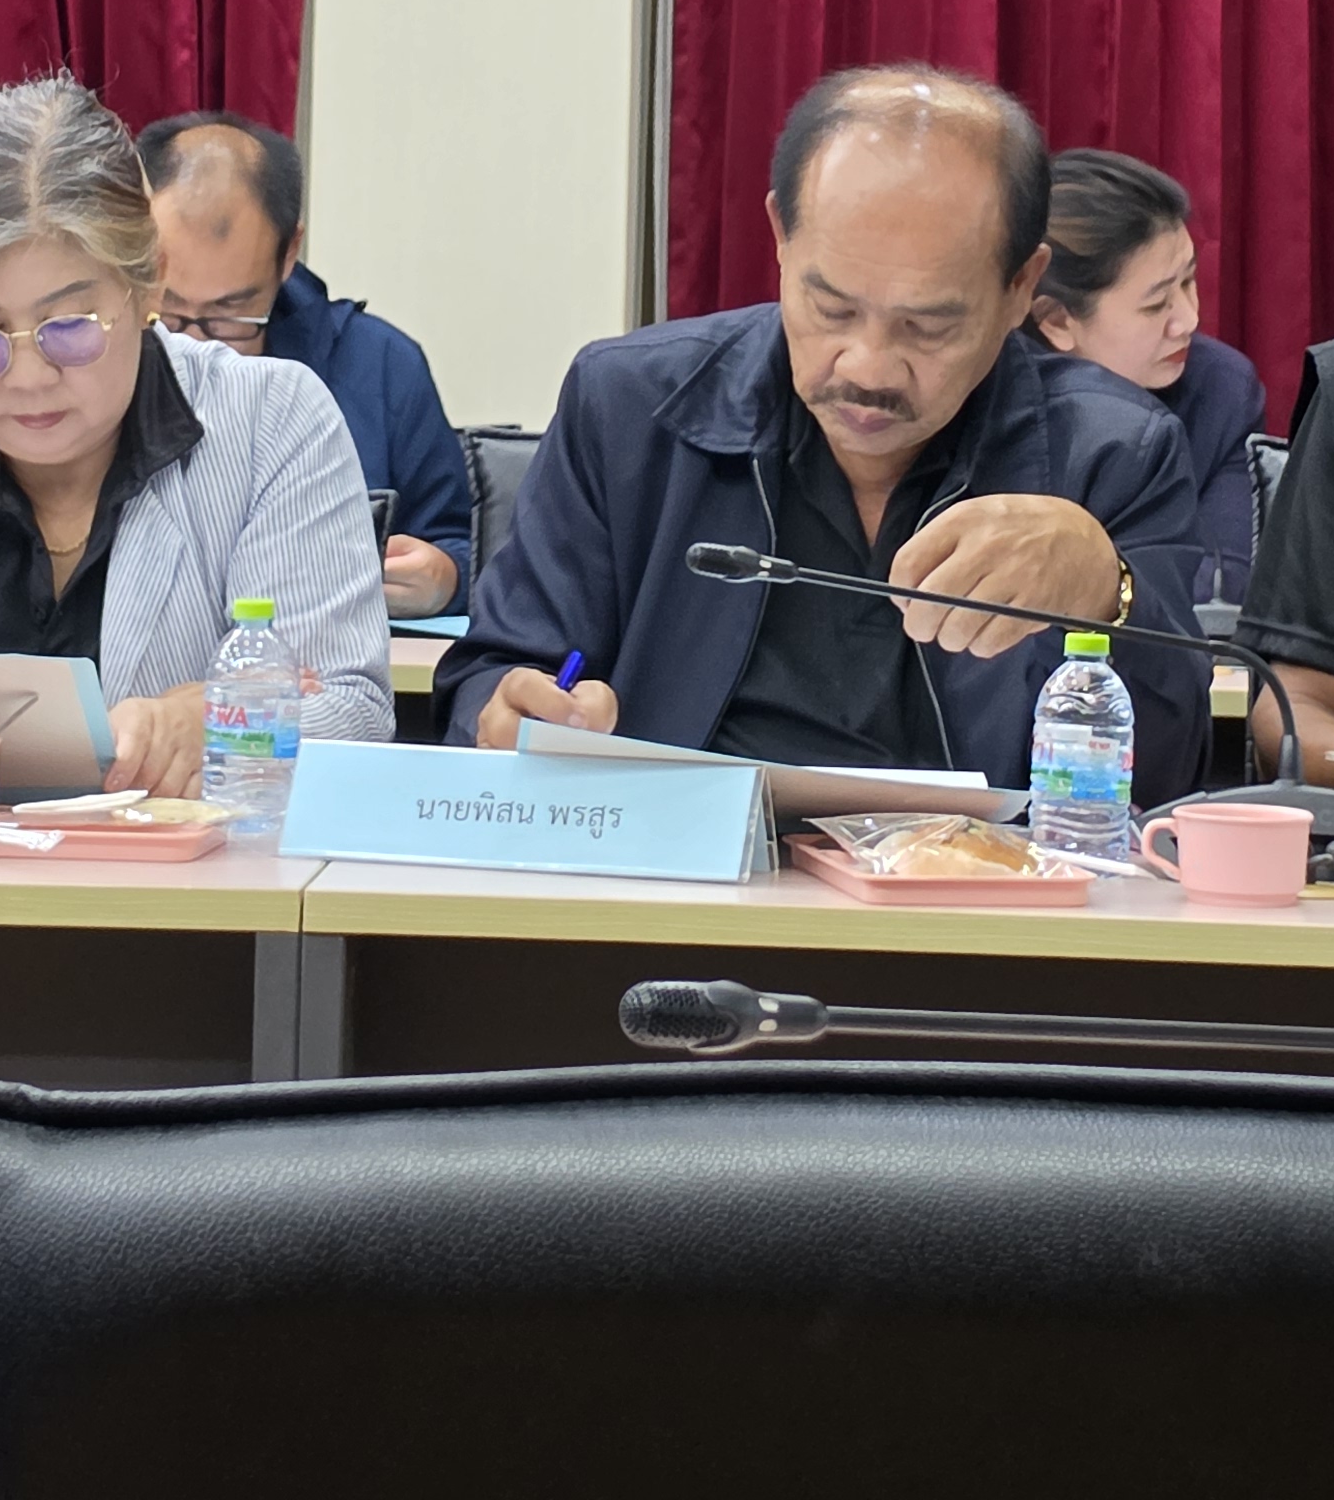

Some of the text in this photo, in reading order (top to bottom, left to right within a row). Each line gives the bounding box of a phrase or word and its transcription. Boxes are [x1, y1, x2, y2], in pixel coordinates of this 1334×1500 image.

[416, 790, 624, 840] นายพิสน พรสูร
